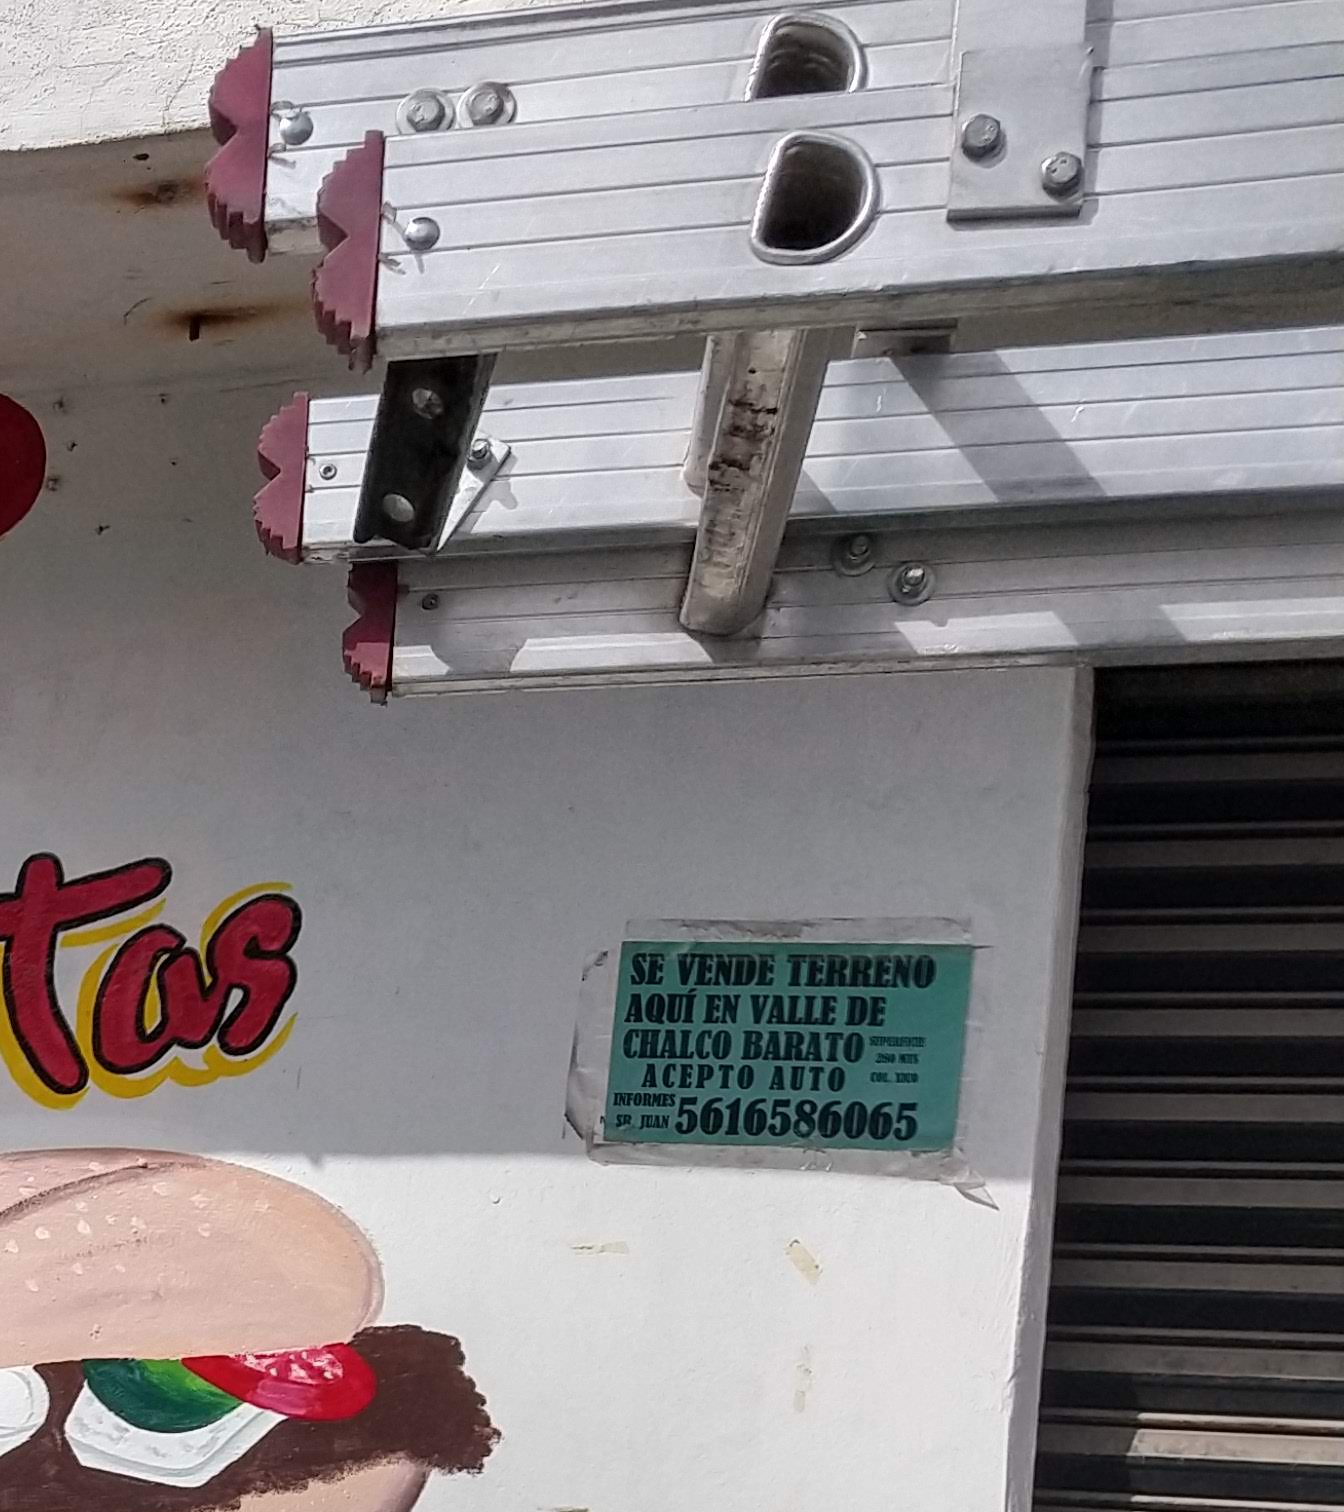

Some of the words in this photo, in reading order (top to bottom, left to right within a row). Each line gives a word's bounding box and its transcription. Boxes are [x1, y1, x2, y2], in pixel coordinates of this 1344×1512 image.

[630, 953, 664, 985] SE
[677, 953, 776, 988] VENDE
[786, 953, 937, 990] TERRENO
[624, 989, 695, 1024] AQUÍ
[703, 993, 742, 1024] EN
[750, 994, 837, 1026] VALLE
[845, 995, 887, 1027] DE
[623, 1028, 732, 1061] CHALCO
[742, 1030, 865, 1064] BARATO
[641, 1063, 754, 1091] ACEPTO
[768, 1065, 845, 1093] AUTO
[613, 1092, 676, 1107] INFORMES
[639, 1114, 670, 1130] JUAN
[674, 1096, 918, 1142] 5616586065
